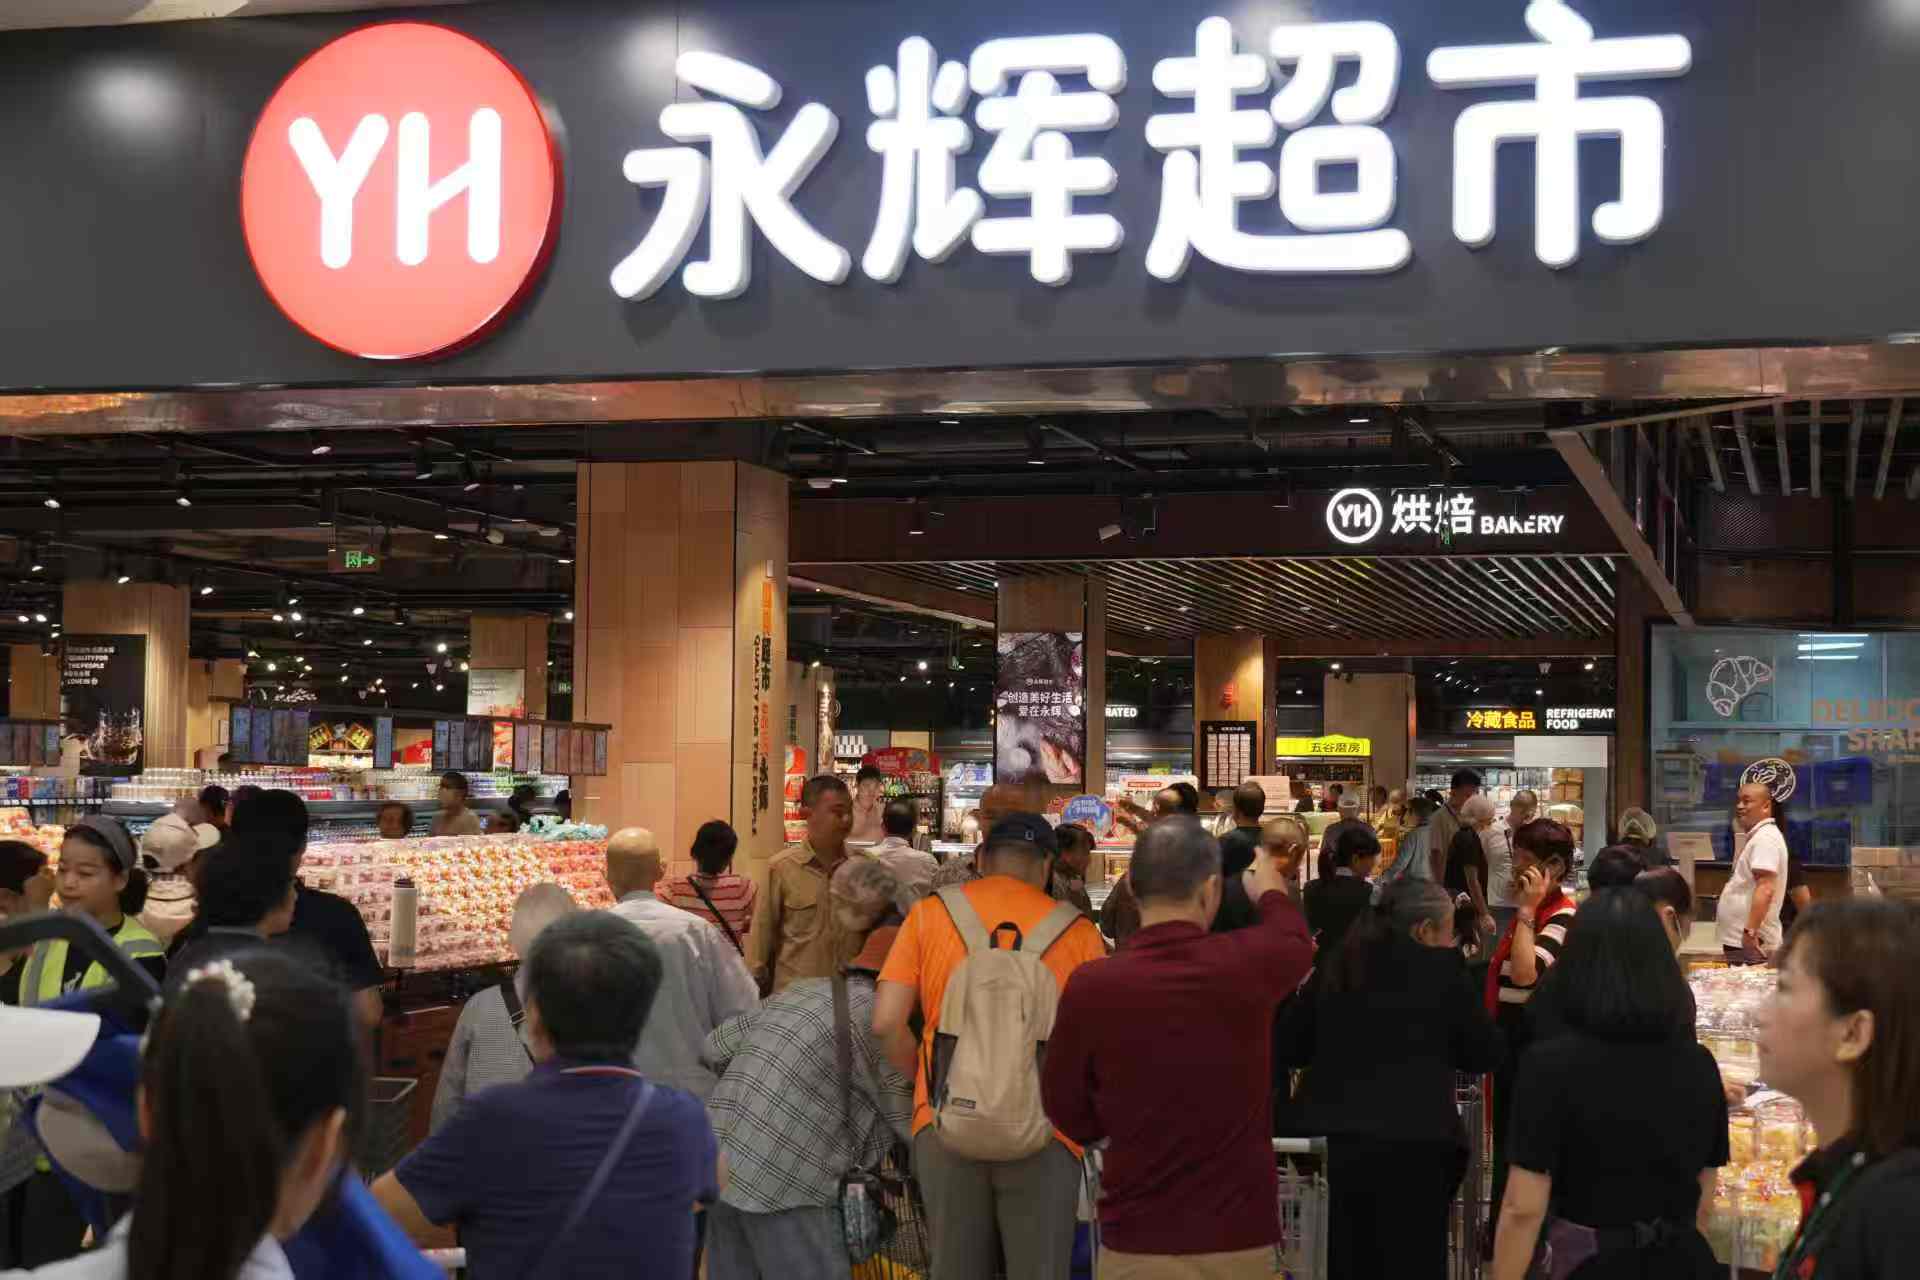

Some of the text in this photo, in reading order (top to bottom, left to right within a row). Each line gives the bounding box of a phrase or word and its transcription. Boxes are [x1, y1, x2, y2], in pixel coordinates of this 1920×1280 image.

[609, 0, 1692, 300] 永辉超市
[288, 107, 503, 269] YH
[1390, 493, 1476, 535] 烘焙
[1480, 515, 1565, 534] BAKERY
[1007, 691, 1073, 704] 创造美好生活
[1018, 705, 1062, 717] 爱在永辉
[1104, 707, 1137, 718] RATED
[1546, 708, 1615, 719] REFRIGERAT
[1466, 711, 1536, 729] 冷藏食品
[1546, 719, 1579, 730] FOOD
[1311, 742, 1361, 753] 五谷磨房
